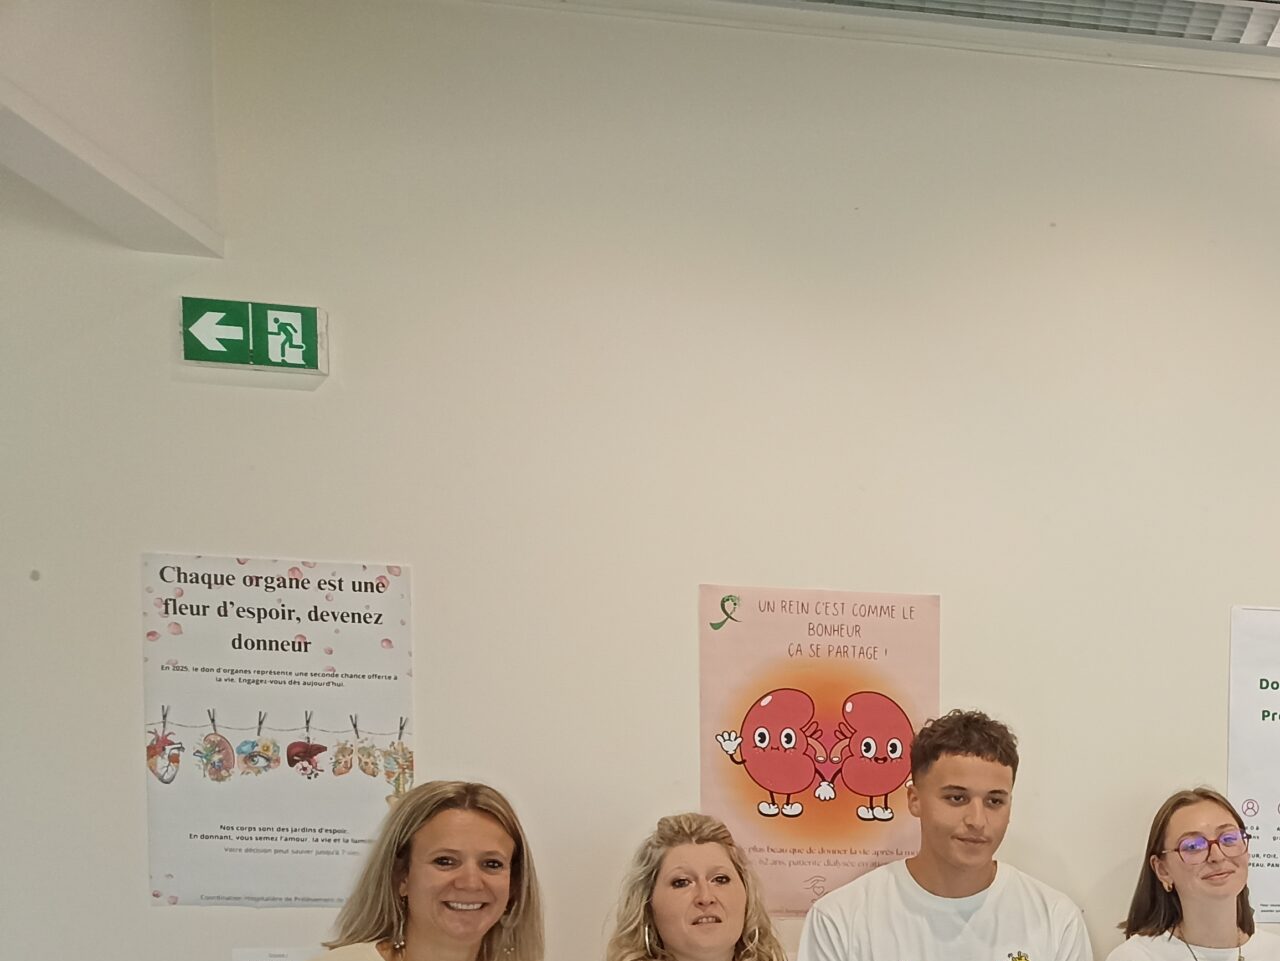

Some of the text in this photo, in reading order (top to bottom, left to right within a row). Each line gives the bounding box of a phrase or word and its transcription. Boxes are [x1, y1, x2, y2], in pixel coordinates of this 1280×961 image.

[159, 565, 386, 593] Chaque organe est une
[163, 598, 383, 625] fleur d'espoir, devenez
[758, 600, 915, 620] UN REIN C'EST COMME LE
[808, 622, 861, 638] BONHEUR
[231, 633, 312, 652] donneur
[809, 644, 821, 658] SE
[828, 644, 878, 660] PARTAGE
